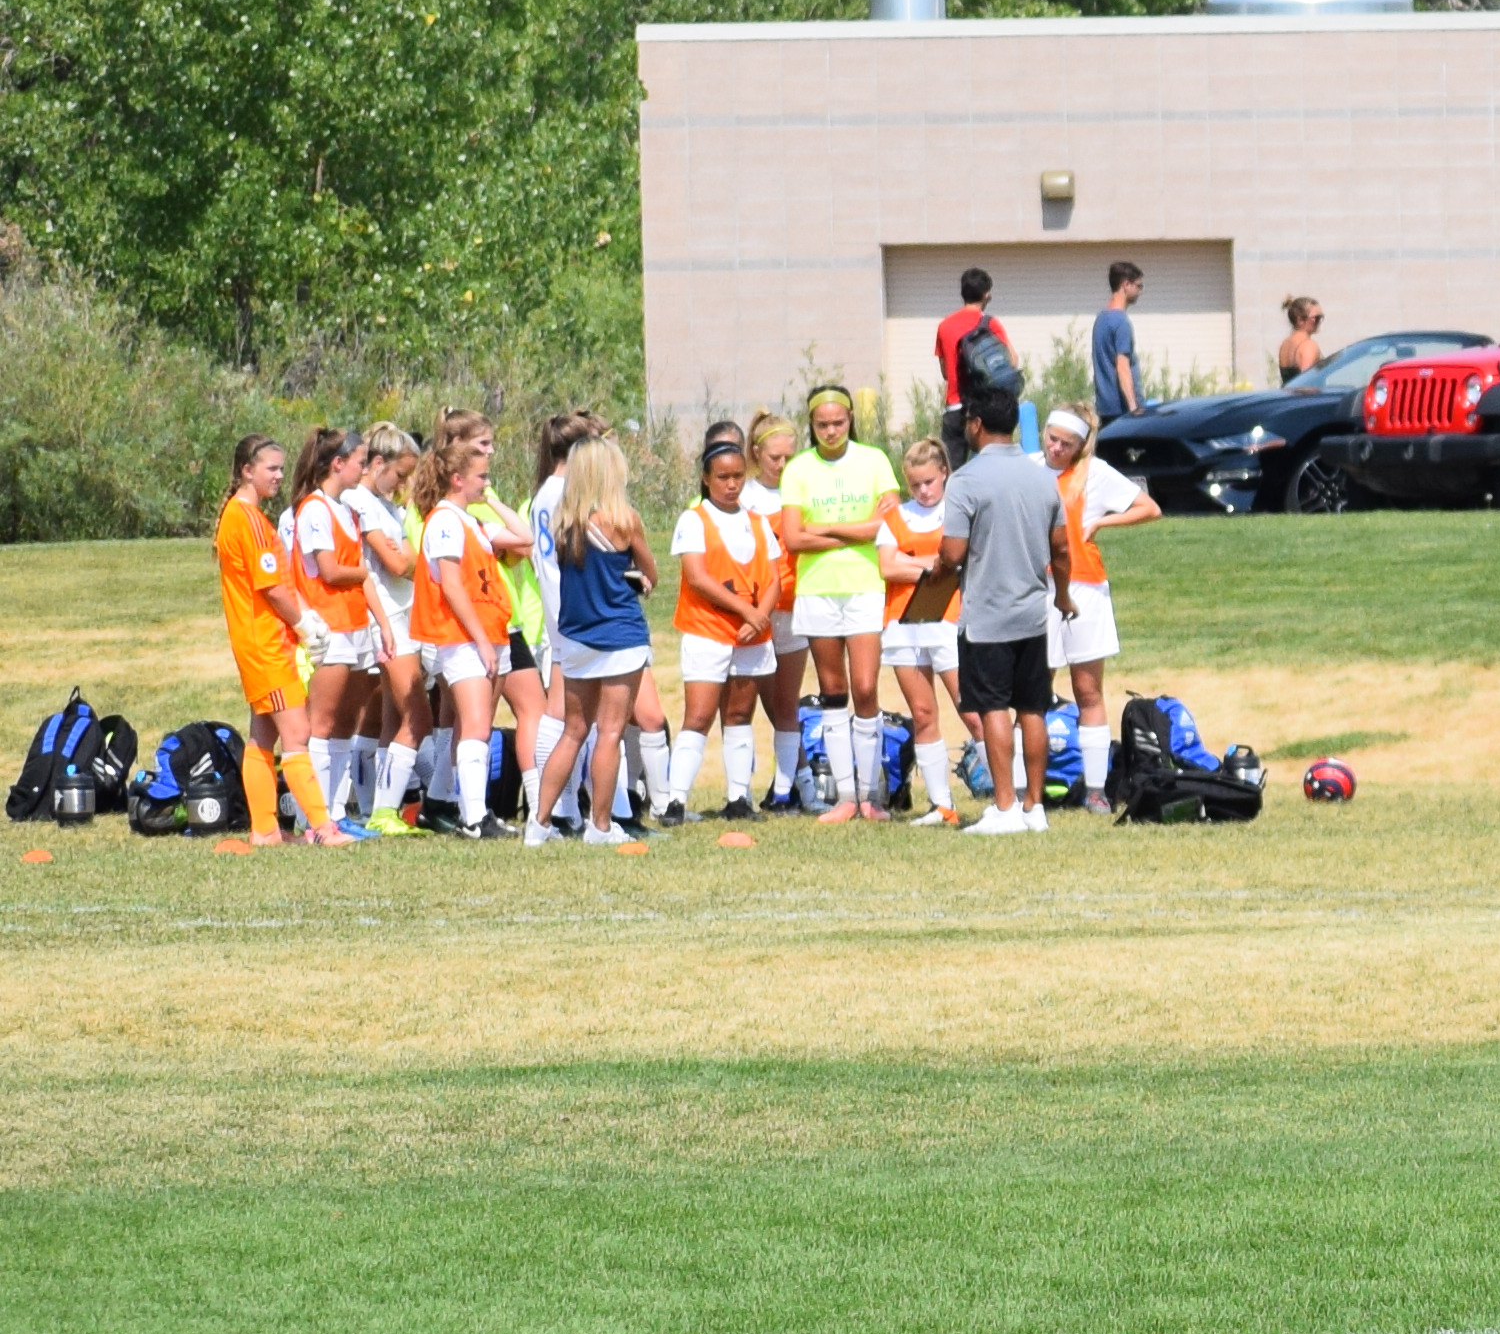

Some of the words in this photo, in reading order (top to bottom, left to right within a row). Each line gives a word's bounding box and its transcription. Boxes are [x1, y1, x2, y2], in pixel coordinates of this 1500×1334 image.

[811, 495, 838, 508] true
[841, 492, 870, 503] blue
[538, 509, 554, 558] 8
